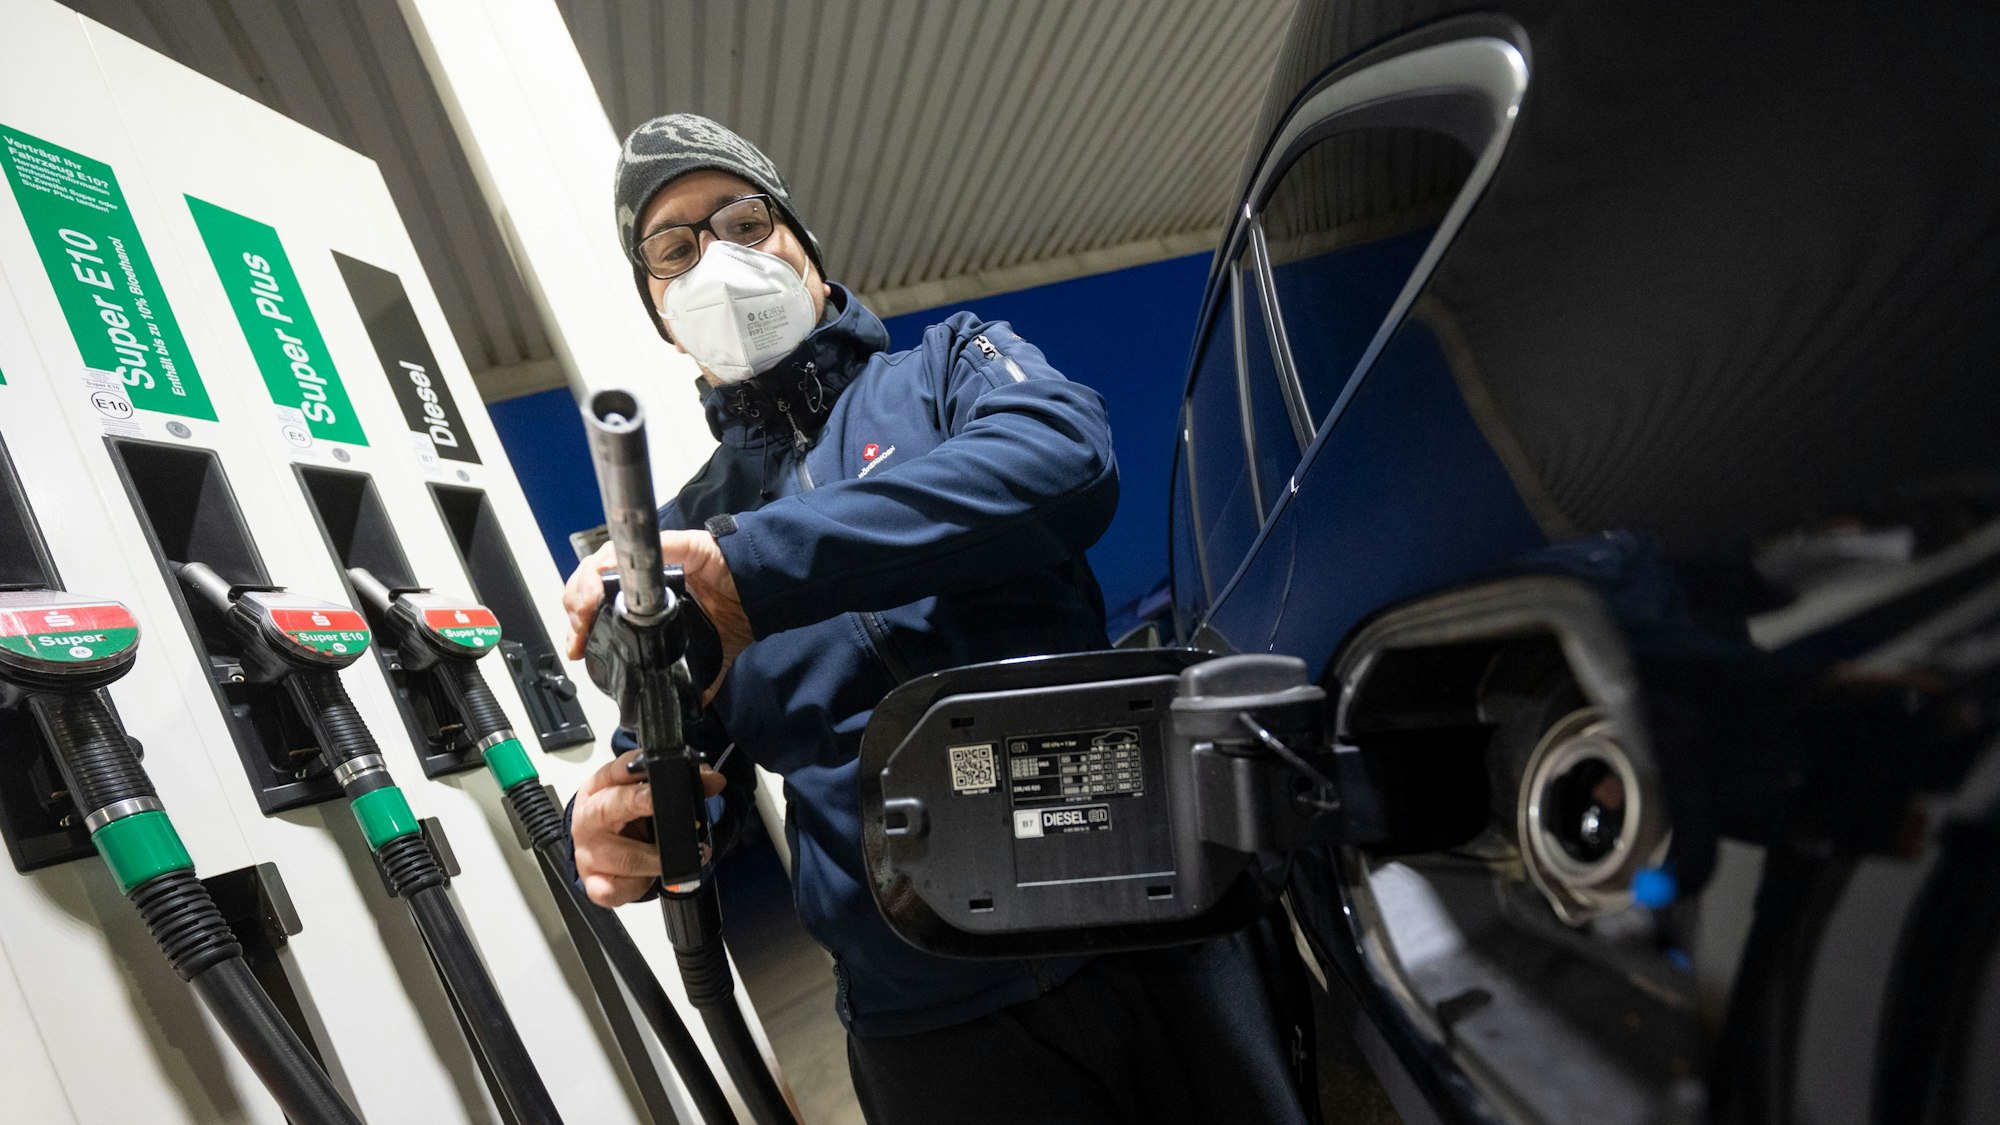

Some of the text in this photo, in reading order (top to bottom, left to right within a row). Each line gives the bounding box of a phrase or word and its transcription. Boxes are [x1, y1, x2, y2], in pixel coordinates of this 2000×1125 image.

[3, 135, 82, 170] Verträgt Ihr
[8, 146, 109, 188] Fahrzeug E10?
[12, 156, 110, 196] Herstellerinformation
[34, 176, 68, 192] Zweifel
[69, 189, 96, 202] Super
[98, 200, 118, 210] oder
[22, 178, 110, 213] Super Plus tanken!
[58, 228, 115, 291] E10
[242, 252, 294, 324] Plus
[107, 236, 187, 396] Enthält bis zu 10% Bioethanol
[92, 294, 156, 390] Super
[274, 328, 336, 424] Super
[96, 398, 128, 412] E10
[399, 360, 458, 448] Diesel
[289, 432, 306, 442] E5
[38, 634, 104, 647] Super
[298, 632, 364, 644] Super E10
[444, 628, 498, 638] Super Plus
[1022, 820, 1034, 828] B7
[1043, 810, 1088, 826] DIESEL
